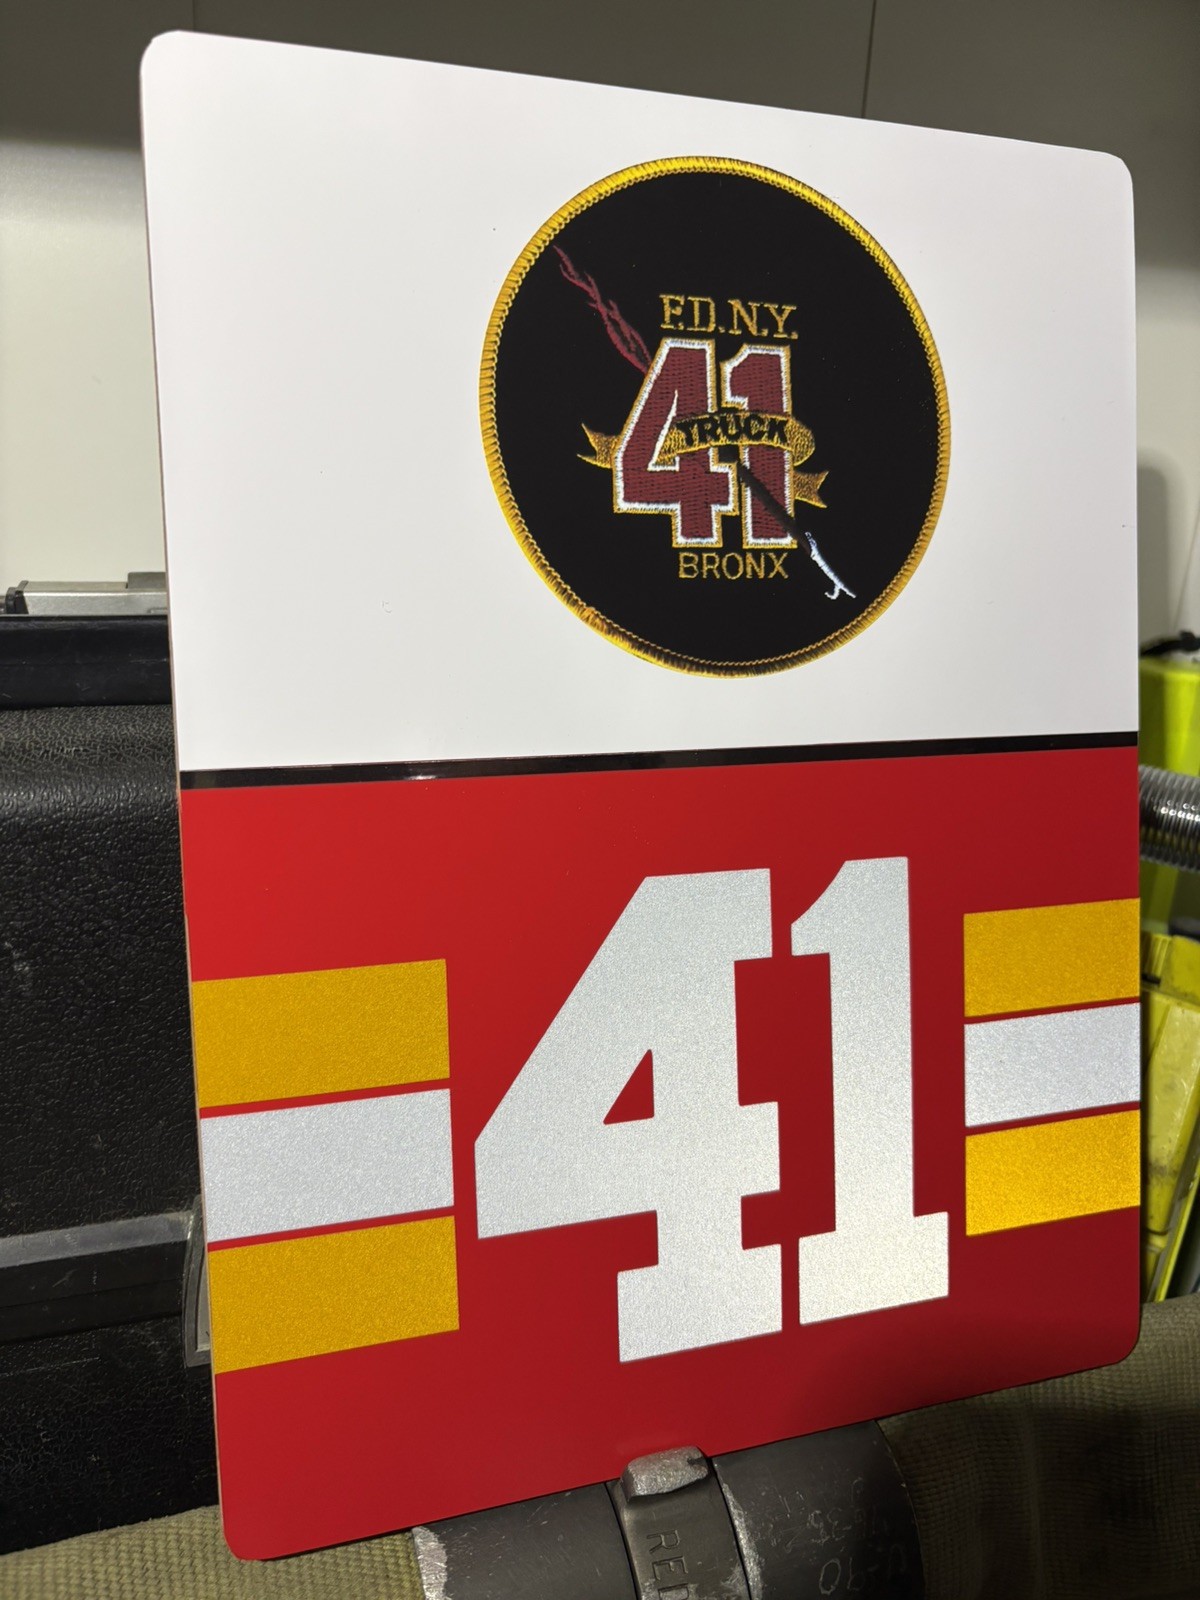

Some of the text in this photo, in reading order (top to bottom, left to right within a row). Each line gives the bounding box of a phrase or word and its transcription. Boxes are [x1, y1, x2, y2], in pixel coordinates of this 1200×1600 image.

[659, 294, 798, 339] F.D.N.Y.
[613, 337, 798, 549] 41
[676, 414, 788, 445] TRUCK
[678, 551, 788, 580] BRONX
[474, 856, 949, 1362] 41
